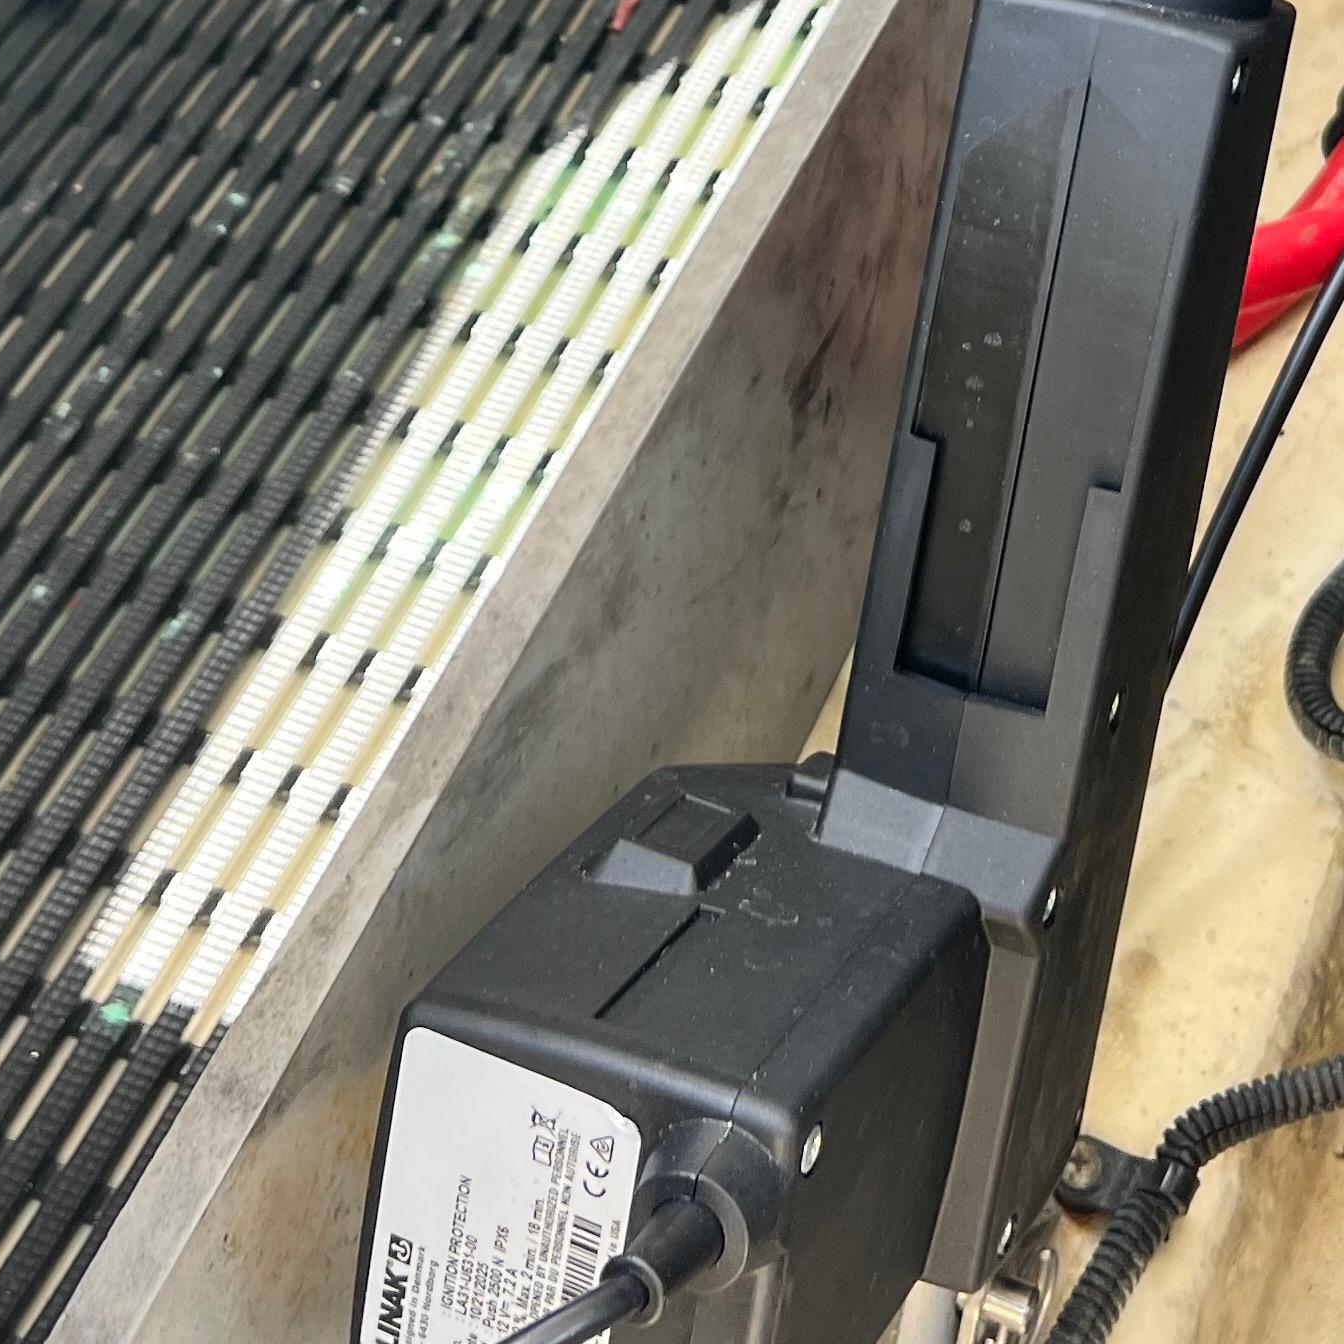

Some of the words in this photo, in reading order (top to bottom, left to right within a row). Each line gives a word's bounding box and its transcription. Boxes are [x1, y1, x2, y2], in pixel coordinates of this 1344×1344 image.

[551, 1128, 569, 1185] PERSONNEL
[449, 1175, 472, 1256] PROTECTION
[551, 1210, 568, 1266] PERSONNEL
[440, 1255, 459, 1310] IGNITION
[487, 1268, 503, 1298] 2500
[482, 1299, 498, 1328] Push
